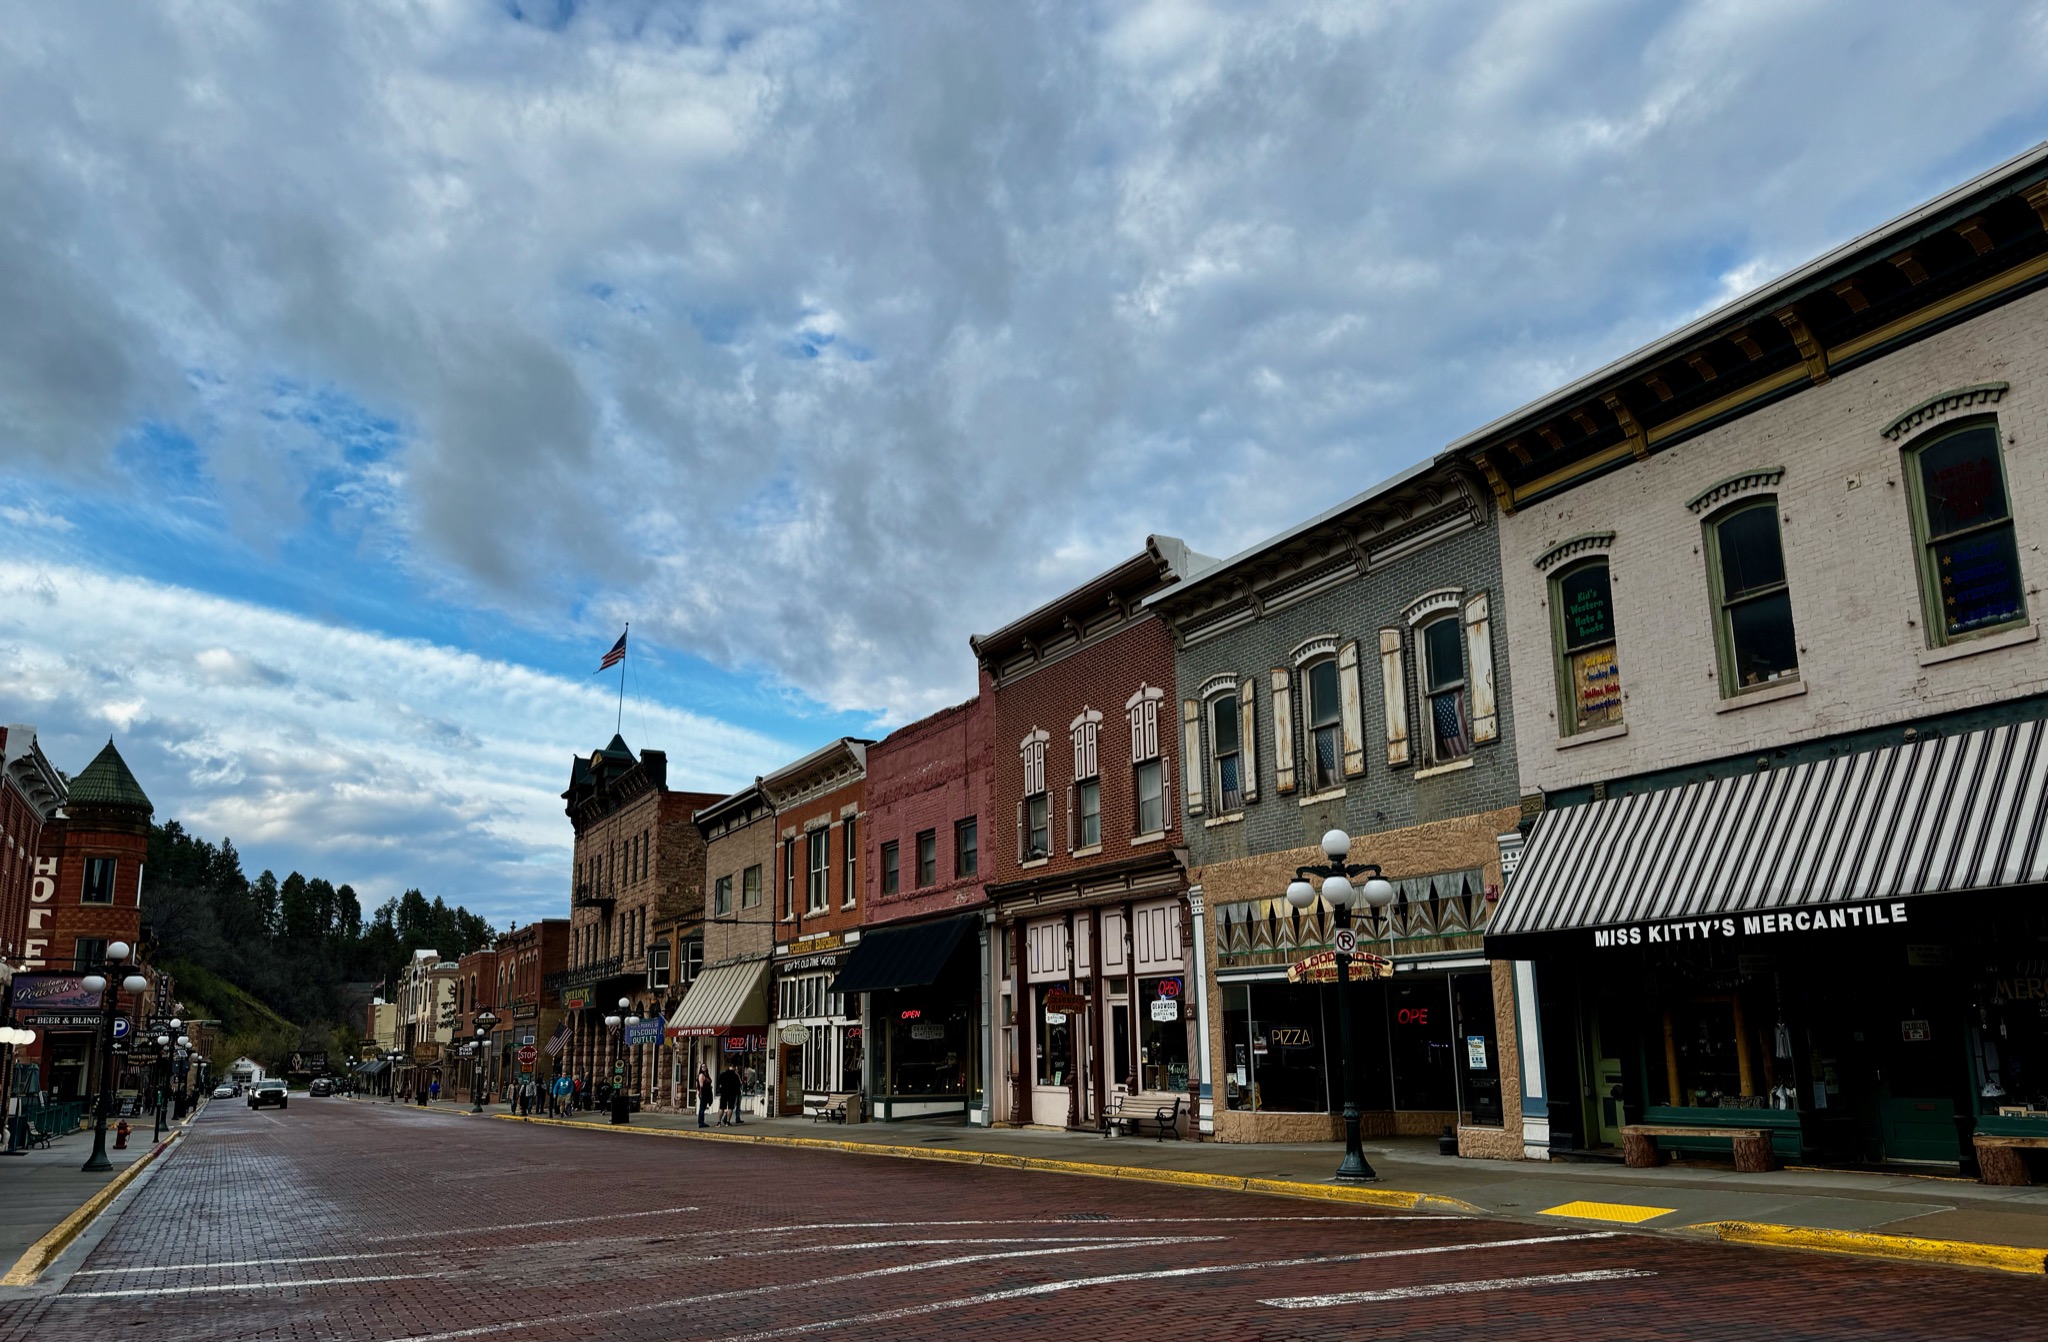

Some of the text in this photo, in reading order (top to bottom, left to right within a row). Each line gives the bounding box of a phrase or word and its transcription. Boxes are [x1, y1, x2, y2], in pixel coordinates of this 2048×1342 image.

[1577, 588, 1598, 602] Kid's
[1569, 600, 1604, 615] Western
[1574, 609, 1605, 627] Hats &
[1580, 622, 1605, 637] Boots
[1584, 683, 1620, 699] Dallas Hats
[1586, 698, 1621, 712] Lonestar
[25, 856, 58, 972] HOTE
[1594, 902, 1908, 947] MISS KITTY'S MERCANTILE
[790, 935, 841, 954] PORTRAIT EMPORIUM
[801, 959, 809, 969] OLD
[1294, 951, 1336, 973] BLOOD
[1316, 967, 1362, 977] SALON
[1158, 980, 1178, 996] OPEN
[1151, 1002, 1176, 1010] DEADWOOD
[37, 1017, 100, 1025] BEER & BLING
[901, 1010, 921, 1019] OPEN
[633, 1035, 657, 1044] OUTLET
[783, 1031, 808, 1043] PHOTOS
[1271, 1029, 1311, 1045] PIZZA
[520, 1051, 536, 1060] STOP
